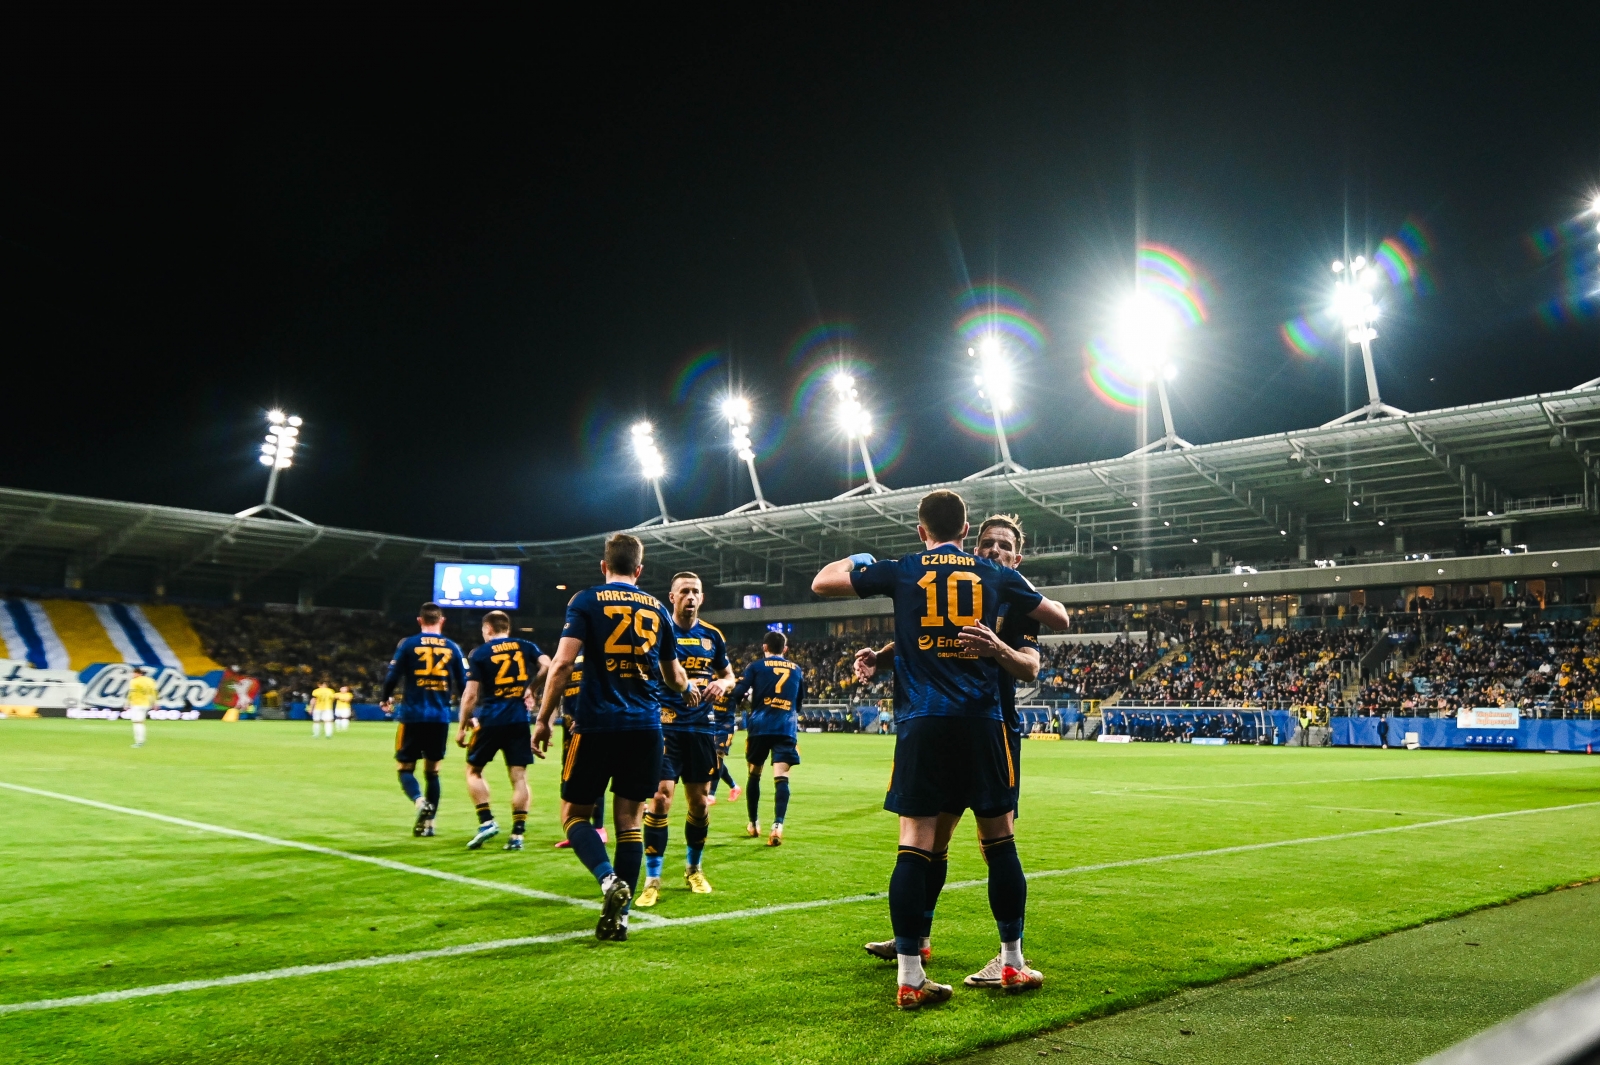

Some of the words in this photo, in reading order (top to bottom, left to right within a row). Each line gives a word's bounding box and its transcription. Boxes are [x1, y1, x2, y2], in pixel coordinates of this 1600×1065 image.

[921, 554, 975, 566] CZUBAK
[596, 590, 660, 609] MARCJANIK
[917, 571, 982, 627] 10
[603, 605, 660, 656] 29
[413, 646, 453, 677] 32
[490, 650, 529, 685] 21
[84, 664, 217, 708] Lulin
[772, 667, 790, 694] 7
